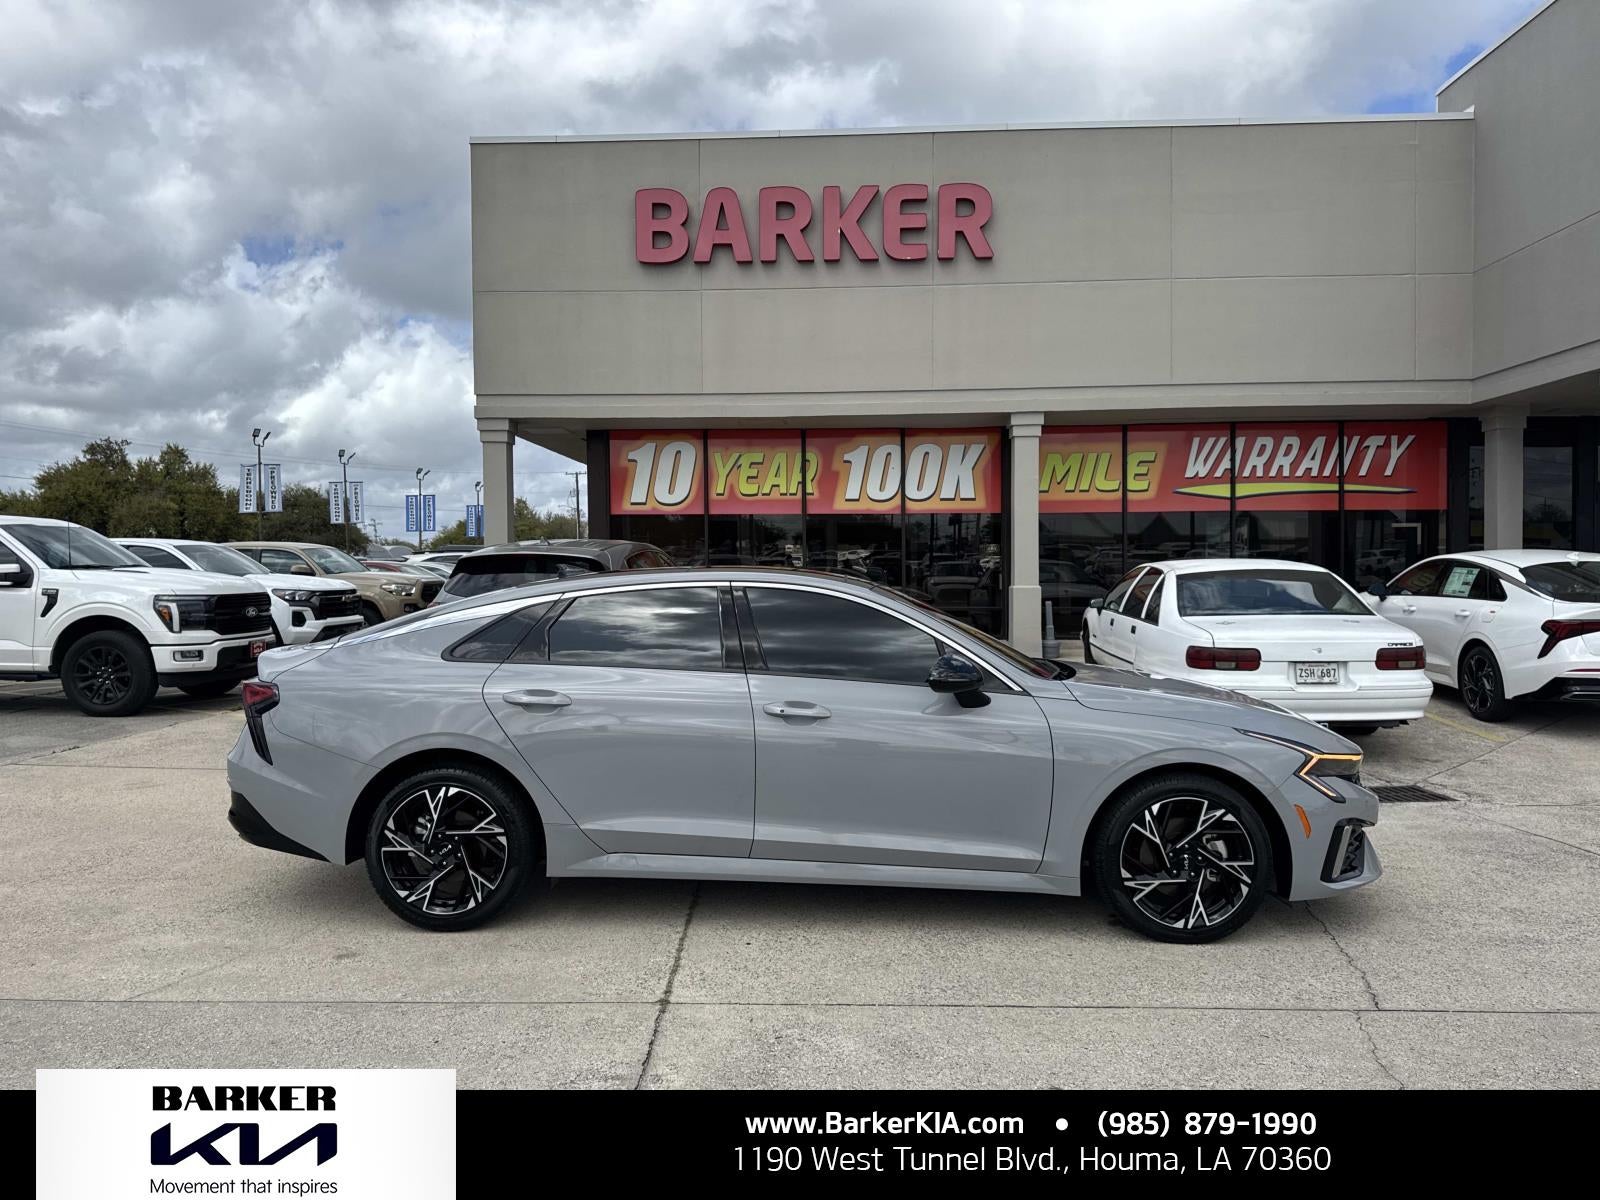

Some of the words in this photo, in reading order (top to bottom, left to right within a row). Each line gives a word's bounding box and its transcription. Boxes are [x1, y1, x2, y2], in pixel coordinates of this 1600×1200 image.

[635, 182, 994, 265] BARKER
[627, 440, 697, 508] 10
[712, 450, 819, 498] YEAR
[843, 442, 986, 503] 100K
[1039, 450, 1158, 494] MILE
[1184, 433, 1416, 480] WARRANTY
[1298, 668, 1315, 678] ZSH
[1320, 668, 1336, 678] 687
